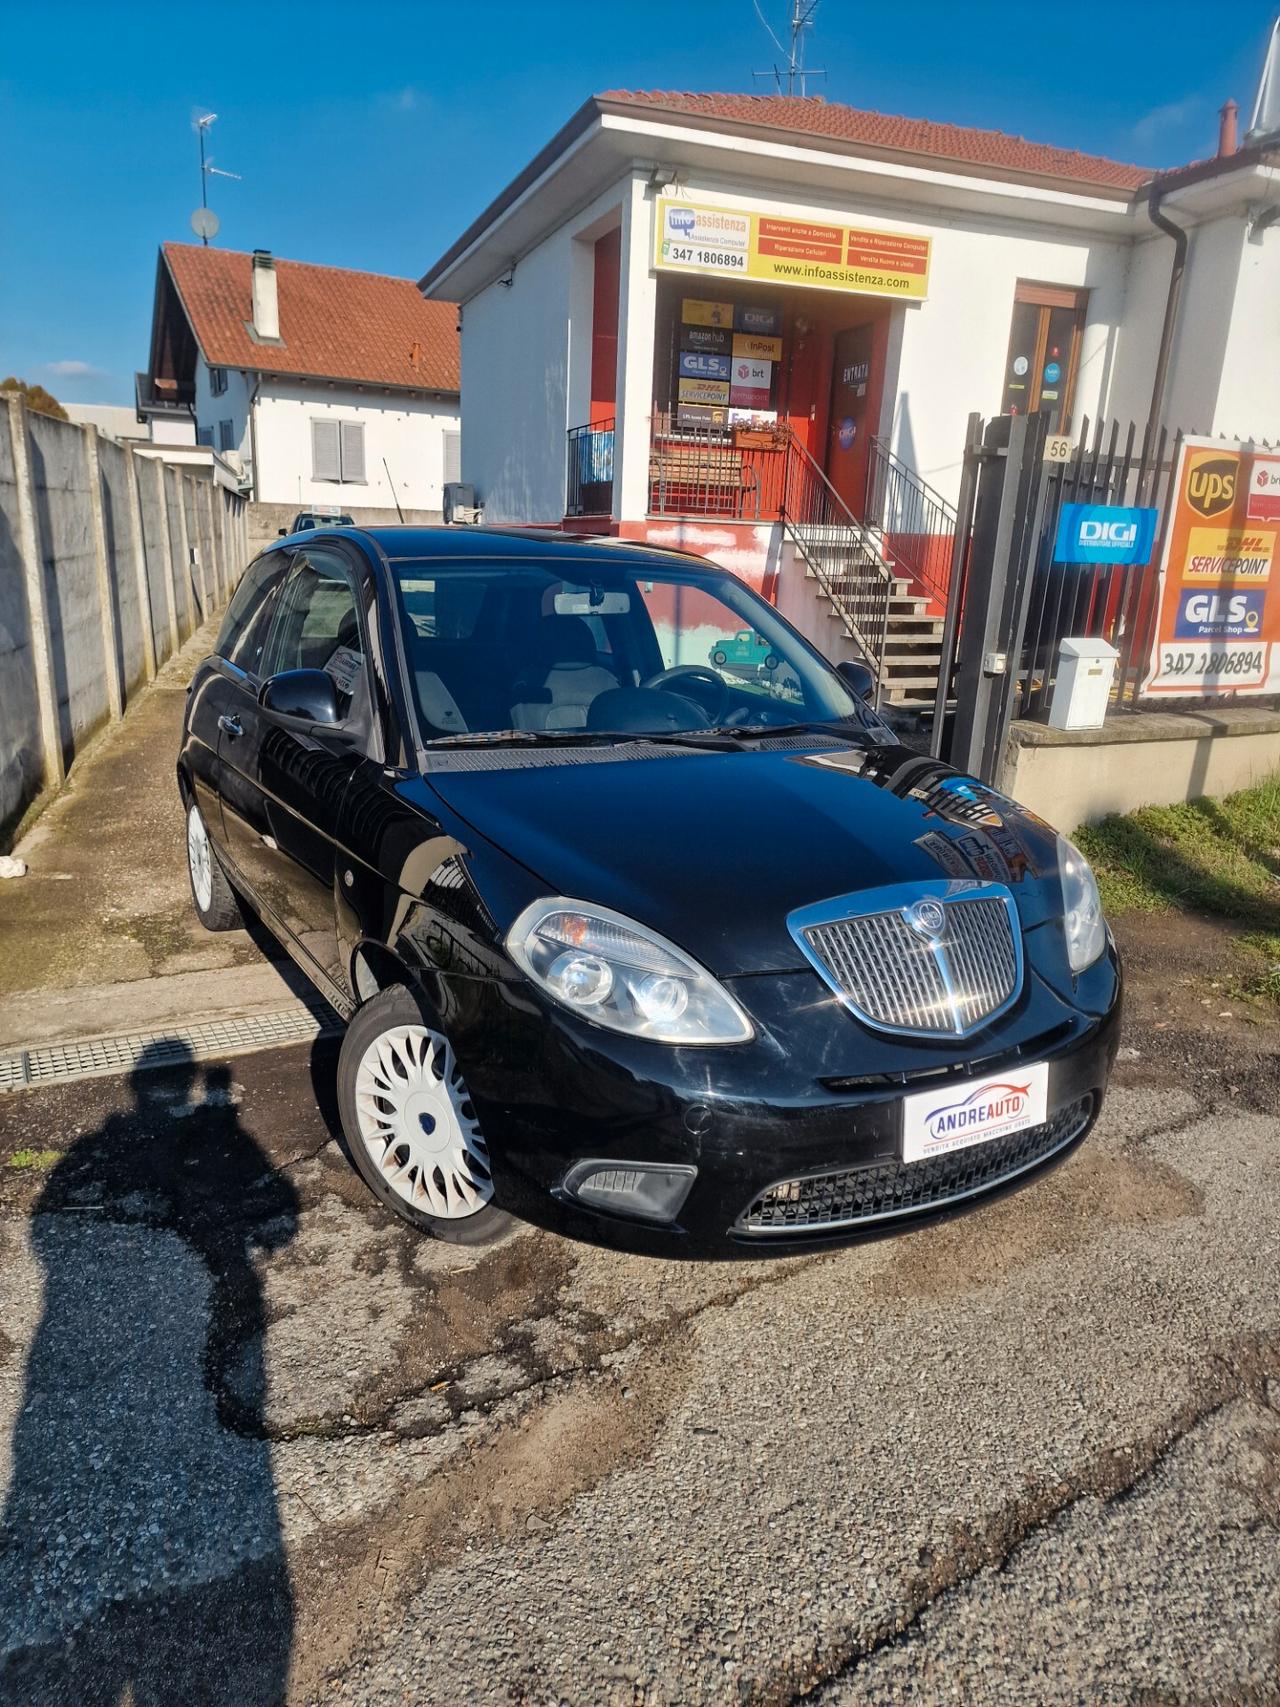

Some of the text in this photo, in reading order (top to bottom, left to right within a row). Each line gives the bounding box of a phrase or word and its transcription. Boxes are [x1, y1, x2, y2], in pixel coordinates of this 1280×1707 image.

[696, 213, 747, 232] assistenza
[720, 237, 746, 247] Computer
[672, 247, 744, 267] 347 1806894
[860, 255, 878, 263] Vendita
[773, 263, 910, 289] www.infoassistenza.com
[750, 342, 775, 352] InPost
[684, 356, 720, 371] GLS
[752, 368, 764, 378] brt
[697, 383, 721, 391] DHL
[1050, 441, 1068, 458] 56
[1190, 471, 1234, 508] ups
[1079, 521, 1138, 541] DIGI
[1188, 556, 1268, 574] SERVICEPOINT
[1185, 594, 1248, 623] GLS
[1198, 625, 1243, 634] Parcel Shop
[1162, 651, 1263, 676] 347 1806894
[936, 1096, 1021, 1134] ANDREAUTO
